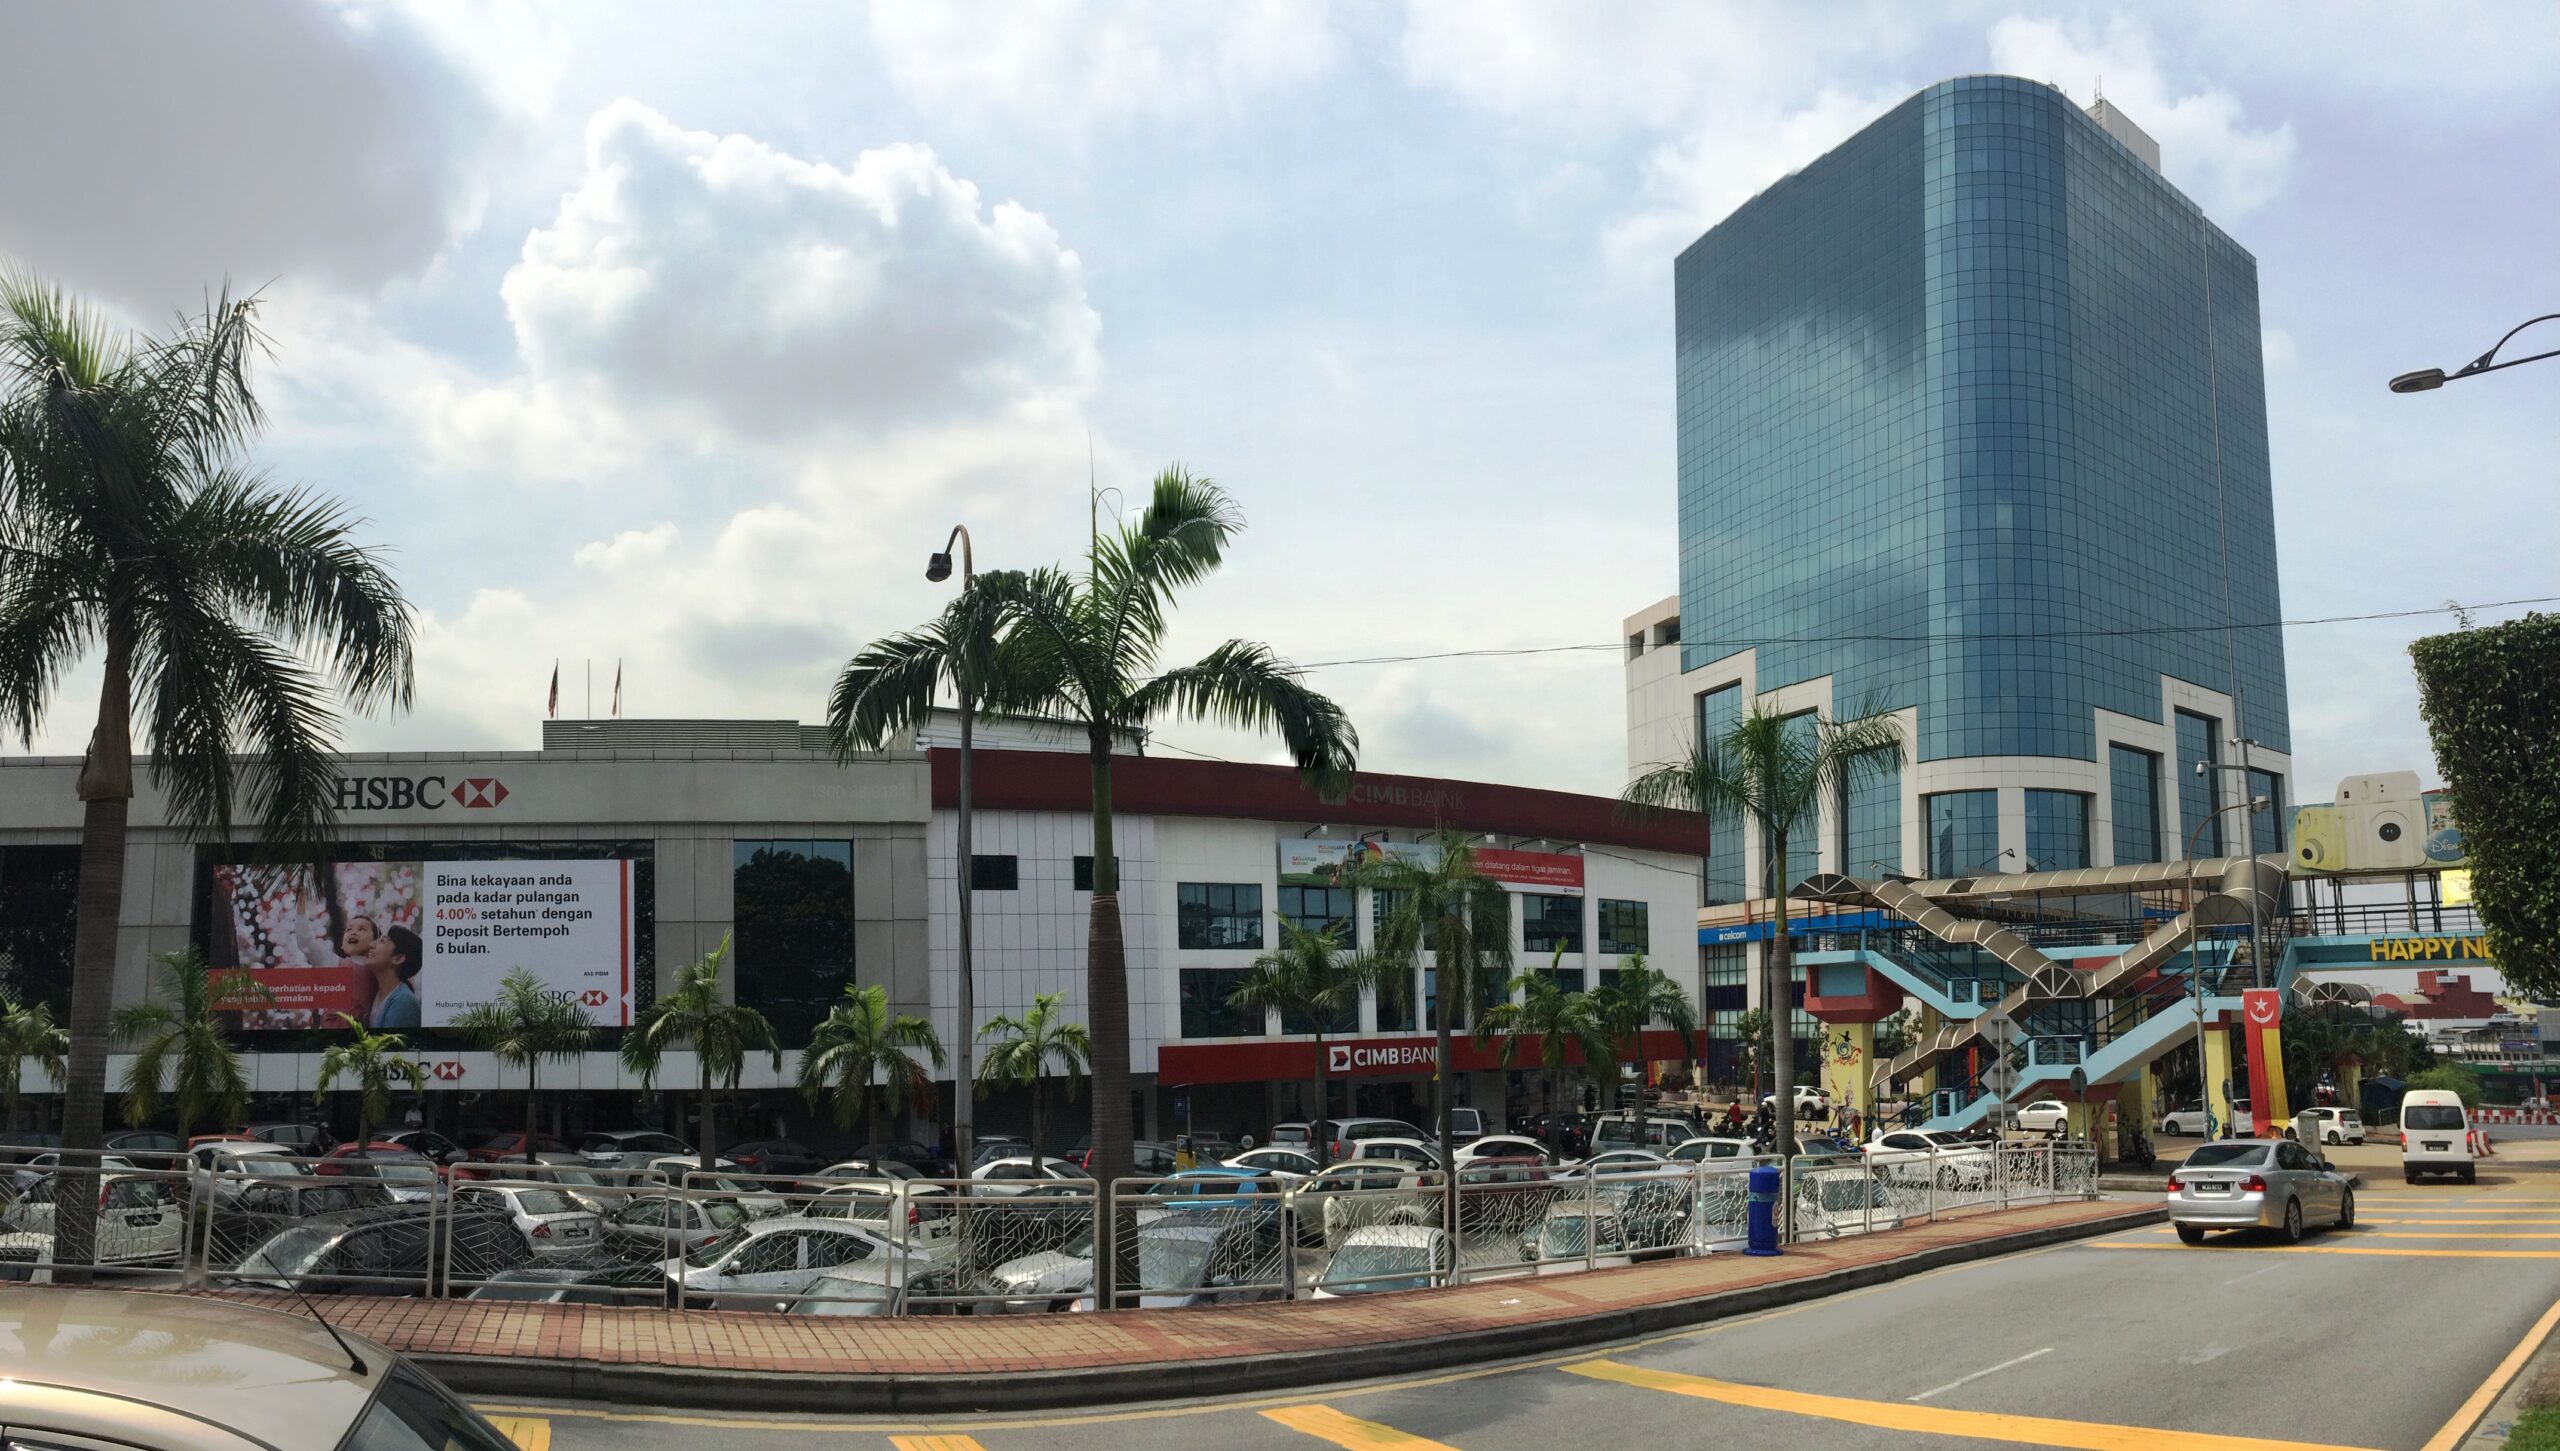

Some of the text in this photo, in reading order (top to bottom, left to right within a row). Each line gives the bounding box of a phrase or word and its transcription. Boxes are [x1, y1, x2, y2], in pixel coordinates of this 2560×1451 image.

[333, 776, 446, 810] HSBC
[1351, 784, 1406, 805] CIMB
[437, 874, 572, 888] Bina kekayaan anda
[436, 890, 580, 906] pada kadar pulangan
[436, 908, 477, 920] 4.00%
[542, 908, 592, 922] dengan
[436, 924, 570, 938] Deposit Bertempoh
[1723, 930, 1747, 940] celcom
[436, 942, 490, 954] 6 bulan.
[2370, 936, 2457, 961] HAPPY
[269, 984, 312, 994] perhatian
[313, 984, 346, 994] kepada
[273, 994, 314, 1002] ermakna
[1354, 1048, 1398, 1067] CIMB
